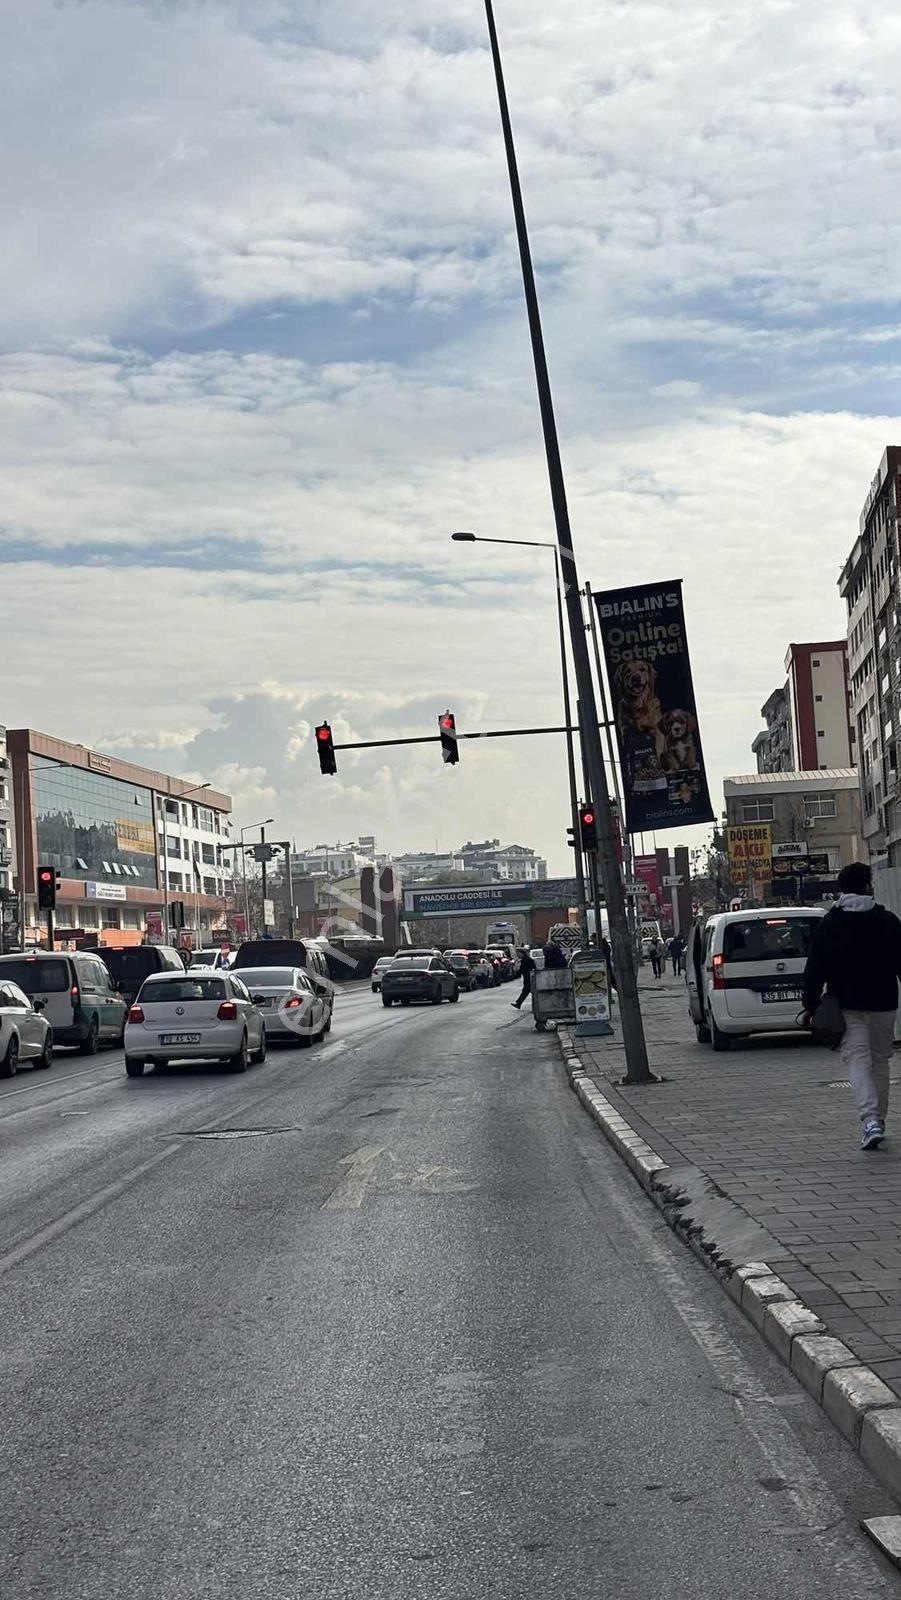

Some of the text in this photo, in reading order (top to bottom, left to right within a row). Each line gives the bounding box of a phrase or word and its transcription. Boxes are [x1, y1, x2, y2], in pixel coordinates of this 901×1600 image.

[600, 593, 679, 618] BIALIN'S
[607, 621, 681, 646] Online
[610, 638, 684, 664] Satışta!
[730, 828, 768, 843] DÖŞEME
[420, 889, 503, 902] ANADOLU CADDESİ İLE
